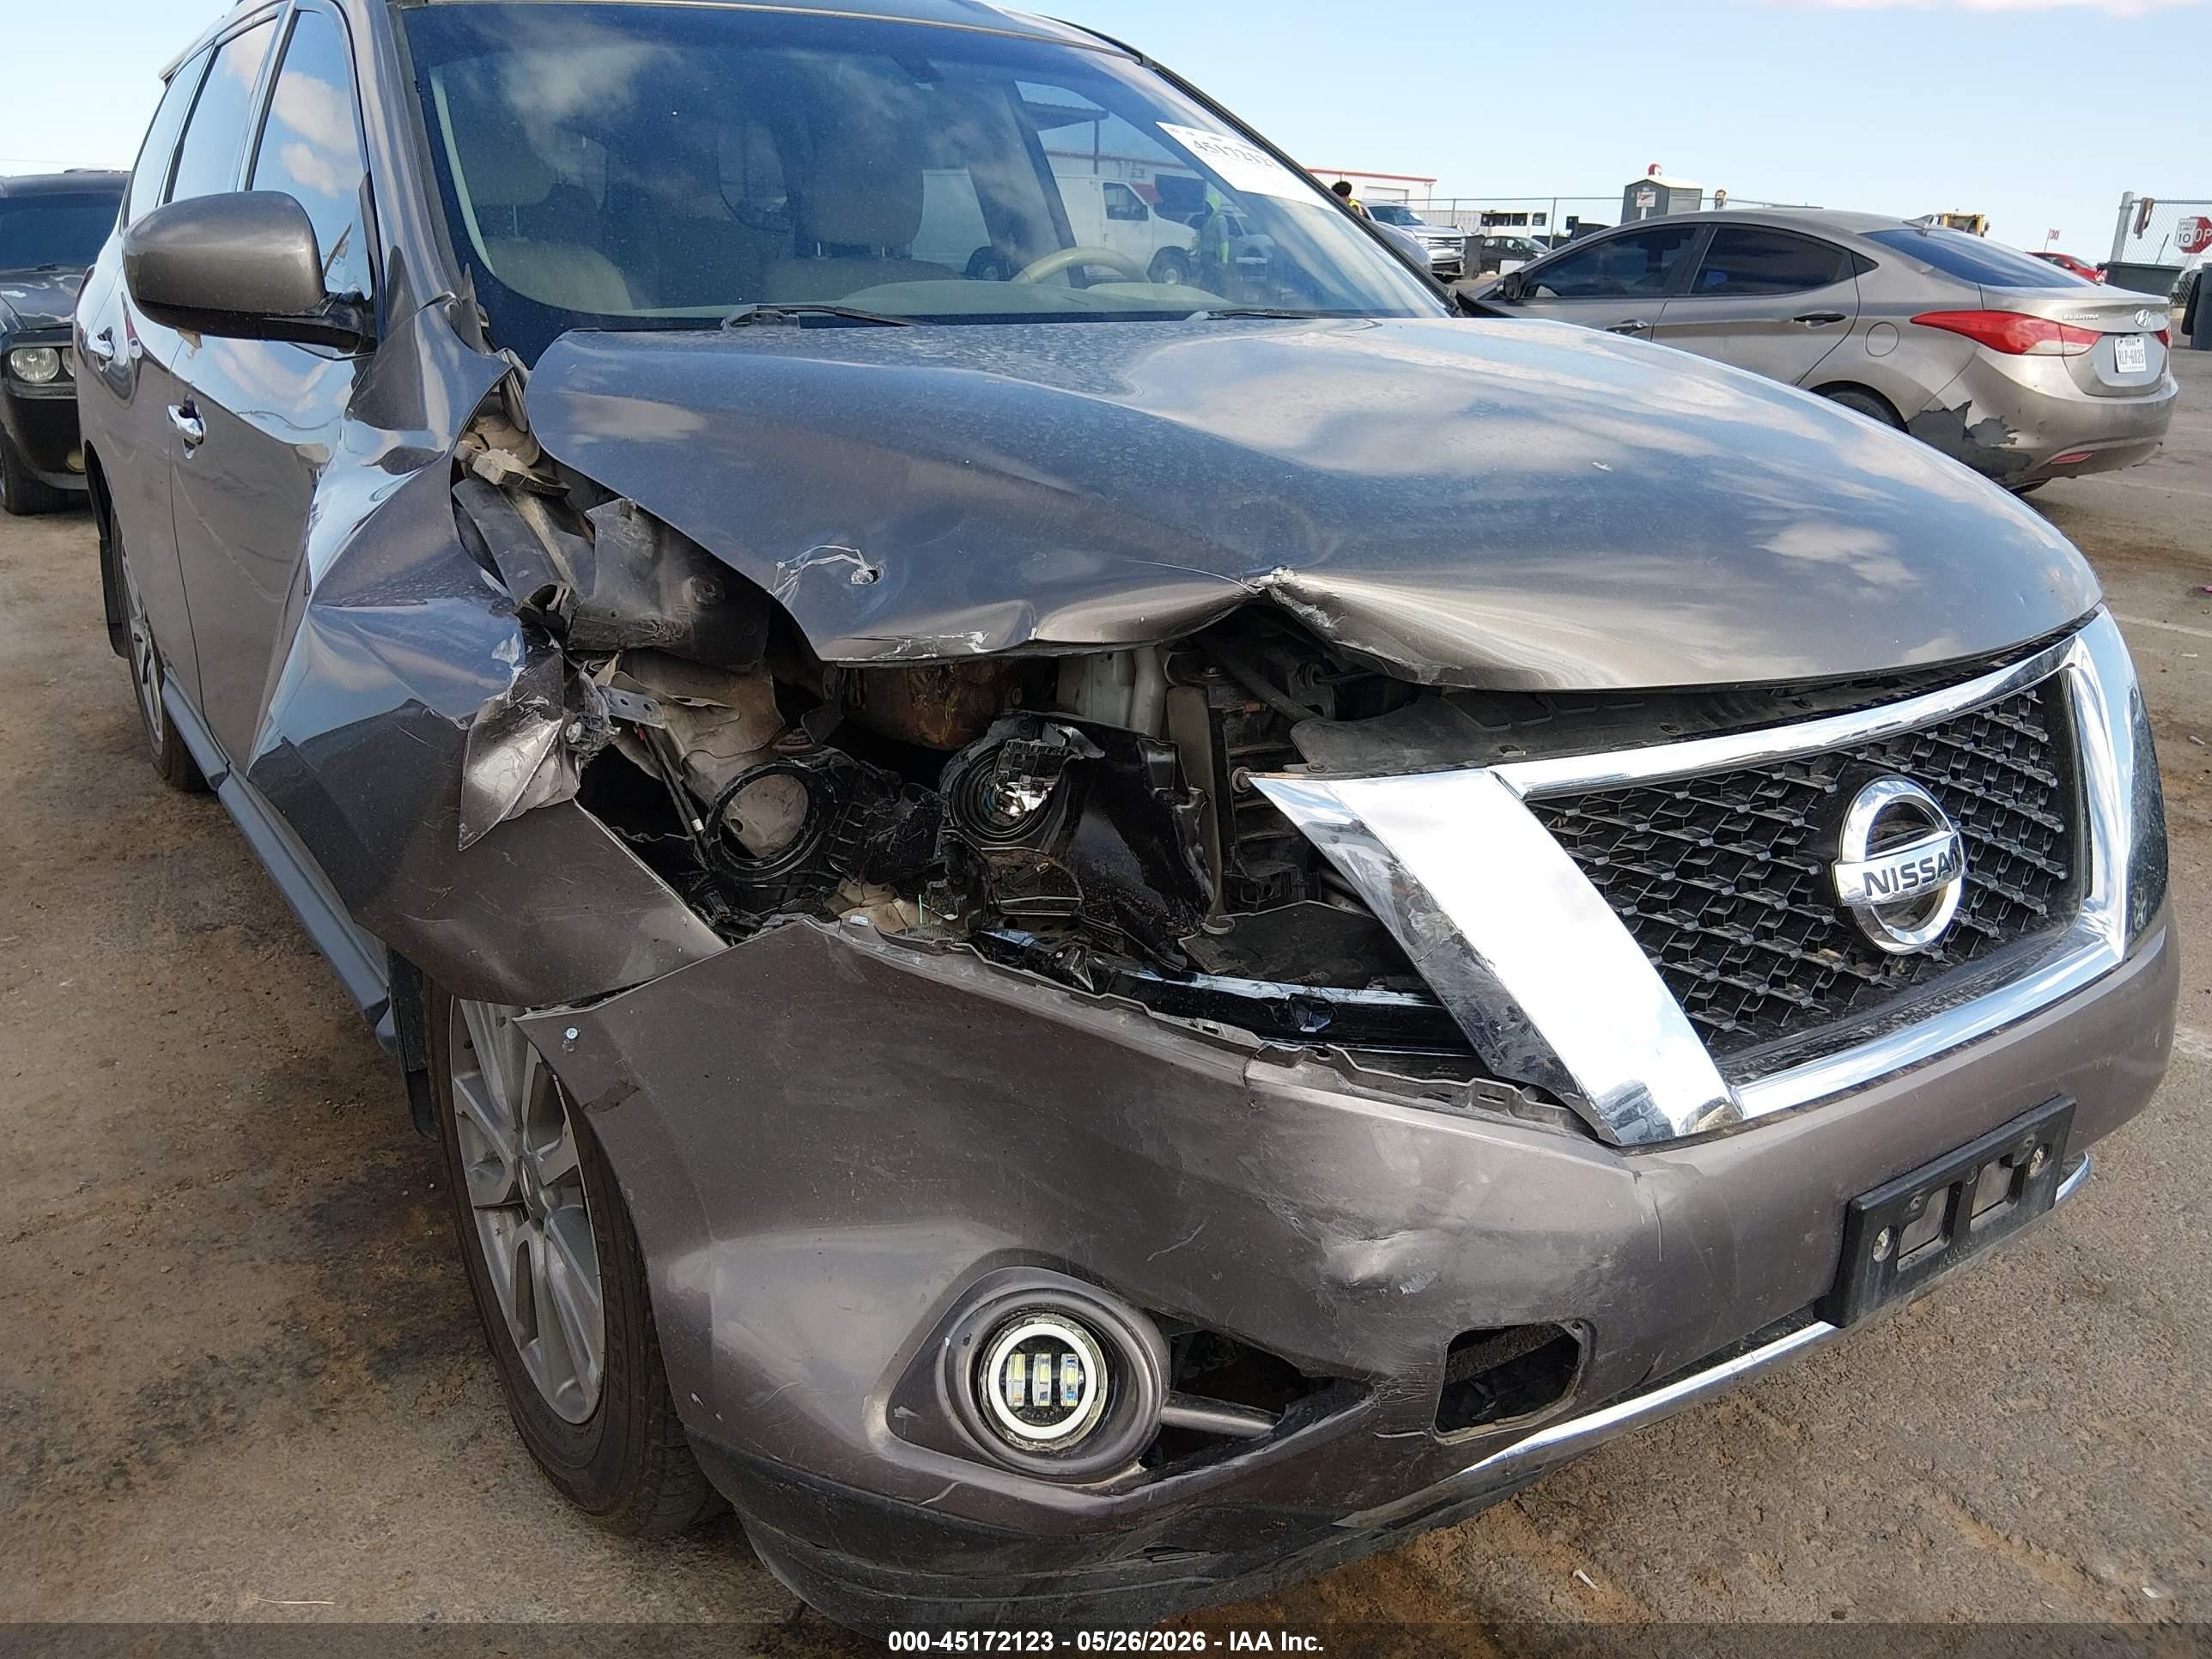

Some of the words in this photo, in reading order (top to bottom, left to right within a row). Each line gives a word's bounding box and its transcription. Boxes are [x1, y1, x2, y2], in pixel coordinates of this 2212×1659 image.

[2178, 233, 2191, 243] 10
[2194, 228, 2212, 242] OP
[1863, 845, 1964, 897] NISSAN
